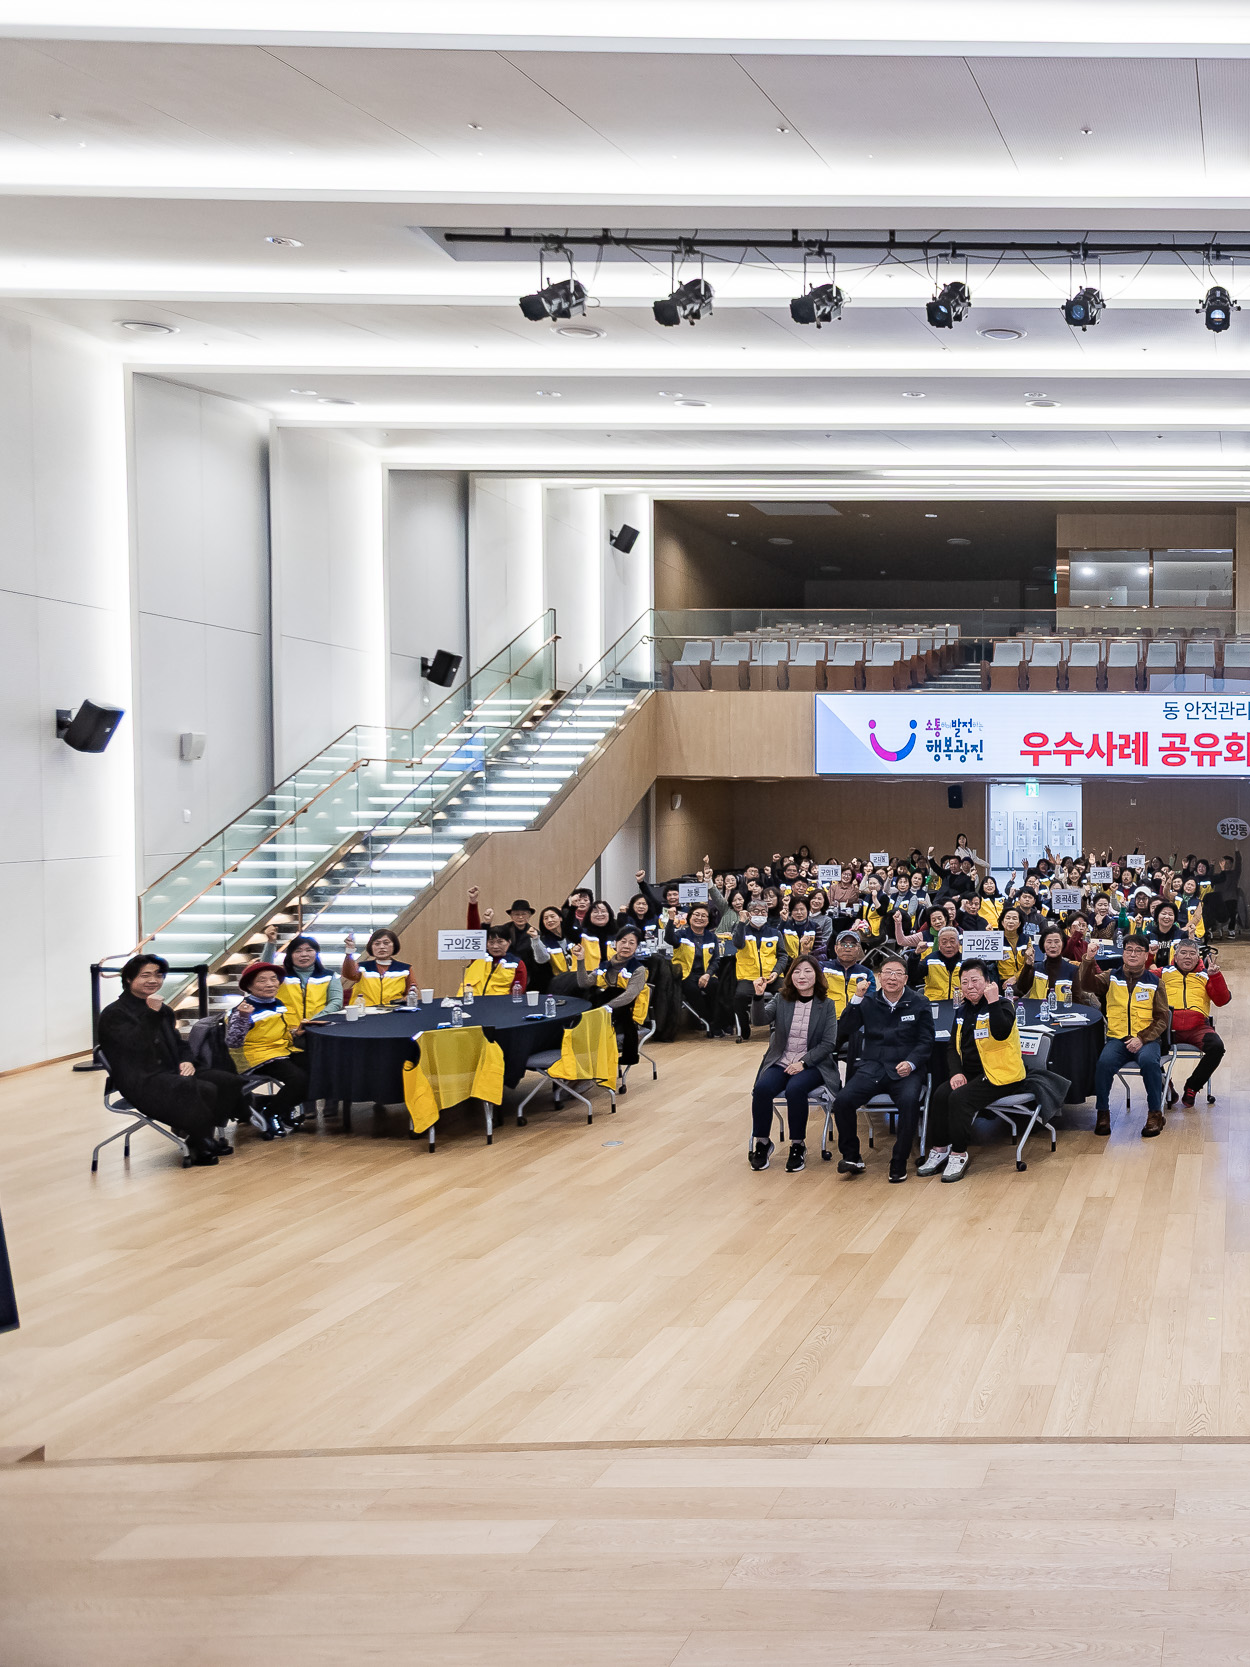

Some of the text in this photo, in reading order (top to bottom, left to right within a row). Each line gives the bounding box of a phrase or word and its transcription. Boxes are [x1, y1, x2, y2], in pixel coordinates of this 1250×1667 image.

[1163, 702, 1180, 720] 동
[925, 737, 983, 763] 행복광진
[1020, 731, 1149, 767] 우수사례
[1220, 823, 1248, 837] 화양동
[820, 868, 839, 877] 구의1동
[687, 888, 700, 897] 능동
[1055, 894, 1078, 904] 중곡4동
[444, 938, 481, 950] 구의2동
[967, 939, 999, 951] 구의2동
